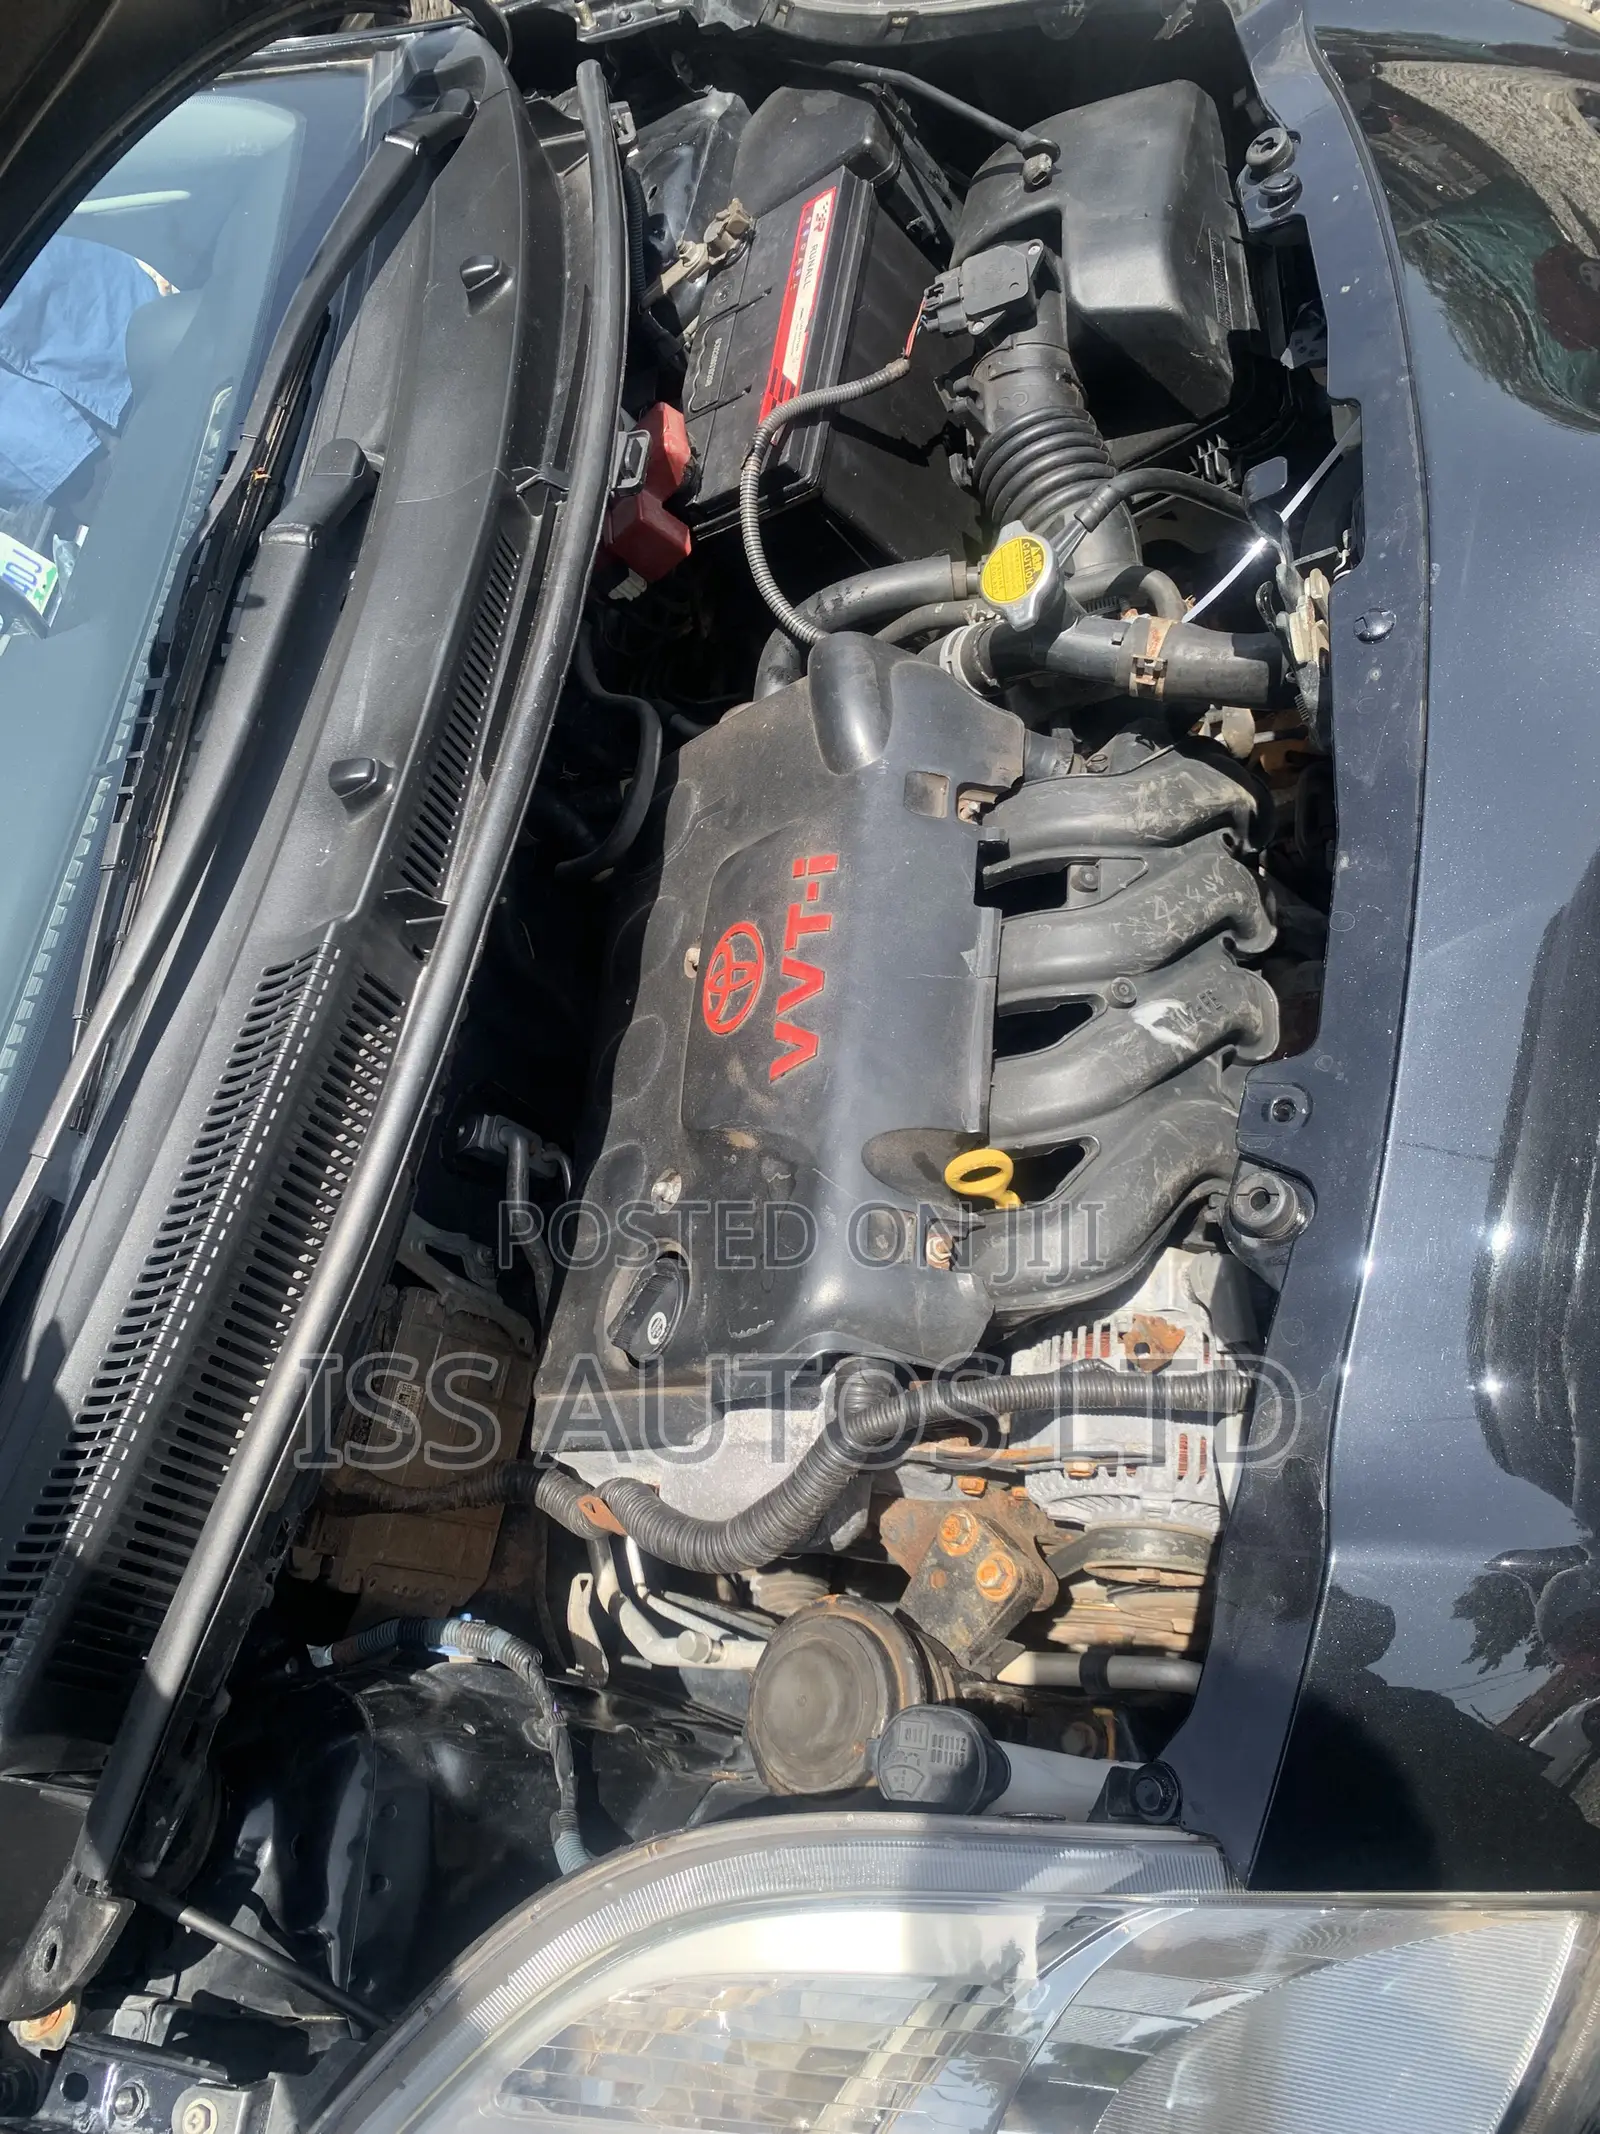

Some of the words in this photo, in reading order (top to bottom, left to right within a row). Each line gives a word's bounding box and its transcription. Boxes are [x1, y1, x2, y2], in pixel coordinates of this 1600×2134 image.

[803, 243, 820, 291] RUNALL
[1022, 542, 1034, 585] CAUTION
[769, 853, 839, 1084] VVT-i
